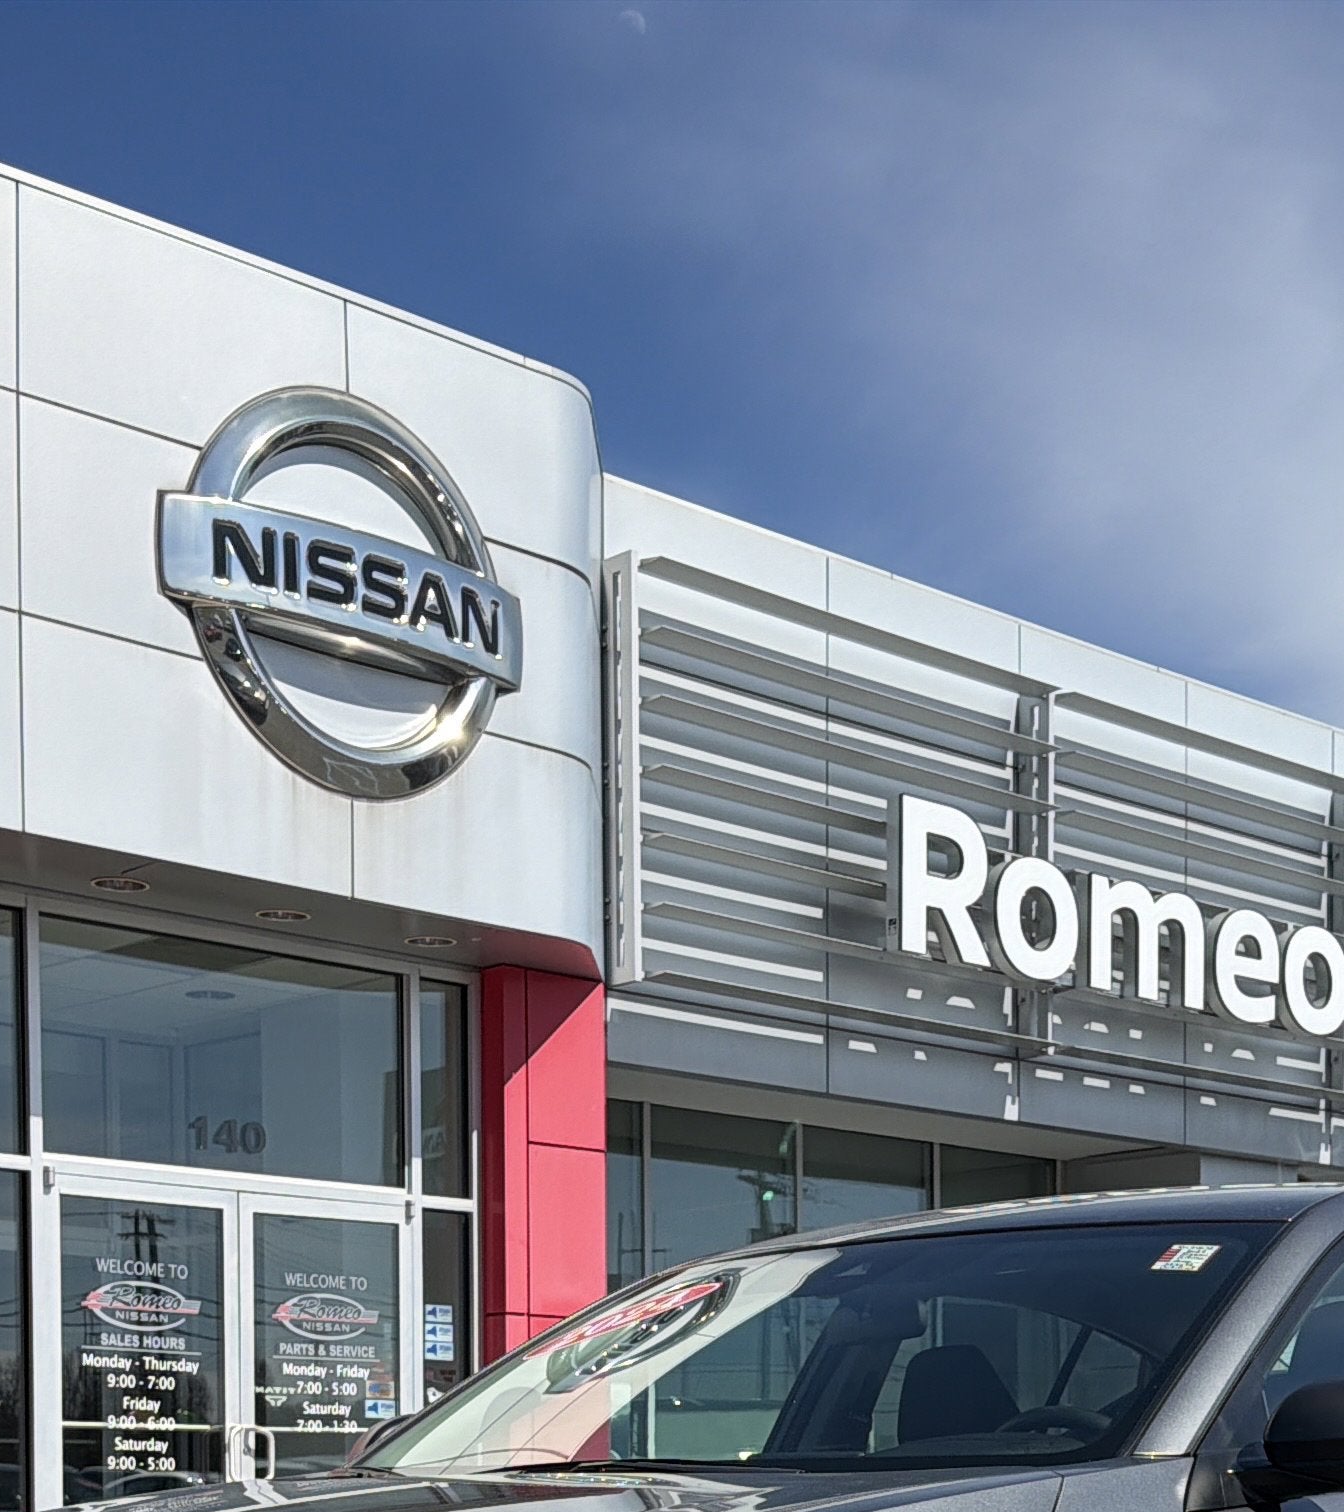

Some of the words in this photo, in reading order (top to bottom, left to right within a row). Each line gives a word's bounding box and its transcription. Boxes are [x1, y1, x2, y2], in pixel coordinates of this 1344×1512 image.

[212, 518, 504, 660] NISSAN
[187, 1115, 267, 1154] 140
[96, 1257, 165, 1278] WELCOME
[170, 1264, 189, 1279] TO
[284, 1272, 347, 1289] WELCOME
[349, 1277, 368, 1291] TO
[103, 1284, 182, 1310] Romeo
[115, 1310, 169, 1323] NISSAN
[291, 1296, 362, 1320] Romeo
[302, 1321, 351, 1333] NISSAN
[100, 1333, 140, 1347] SALES
[143, 1335, 186, 1351] HOURS
[279, 1342, 316, 1355] PARTS
[318, 1344, 327, 1356] &
[329, 1344, 376, 1358] SERVICE
[81, 1352, 133, 1372] Monday
[142, 1356, 200, 1376] Thursday
[282, 1362, 328, 1379] Monday
[336, 1364, 371, 1381] Friday
[107, 1373, 137, 1389] 9:00
[147, 1375, 176, 1391] 7:00
[296, 1381, 323, 1395] 7:00
[331, 1382, 358, 1396] 5:00
[122, 1396, 161, 1414] Friday
[302, 1401, 352, 1417] Saturday
[107, 1415, 137, 1430] 9:00
[147, 1416, 176, 1432] 6:00
[296, 1420, 323, 1433] 7:00
[332, 1420, 358, 1434] 1:30
[114, 1436, 169, 1454] Saturday
[107, 1456, 137, 1471] 9:00
[147, 1457, 176, 1472] 5:00
